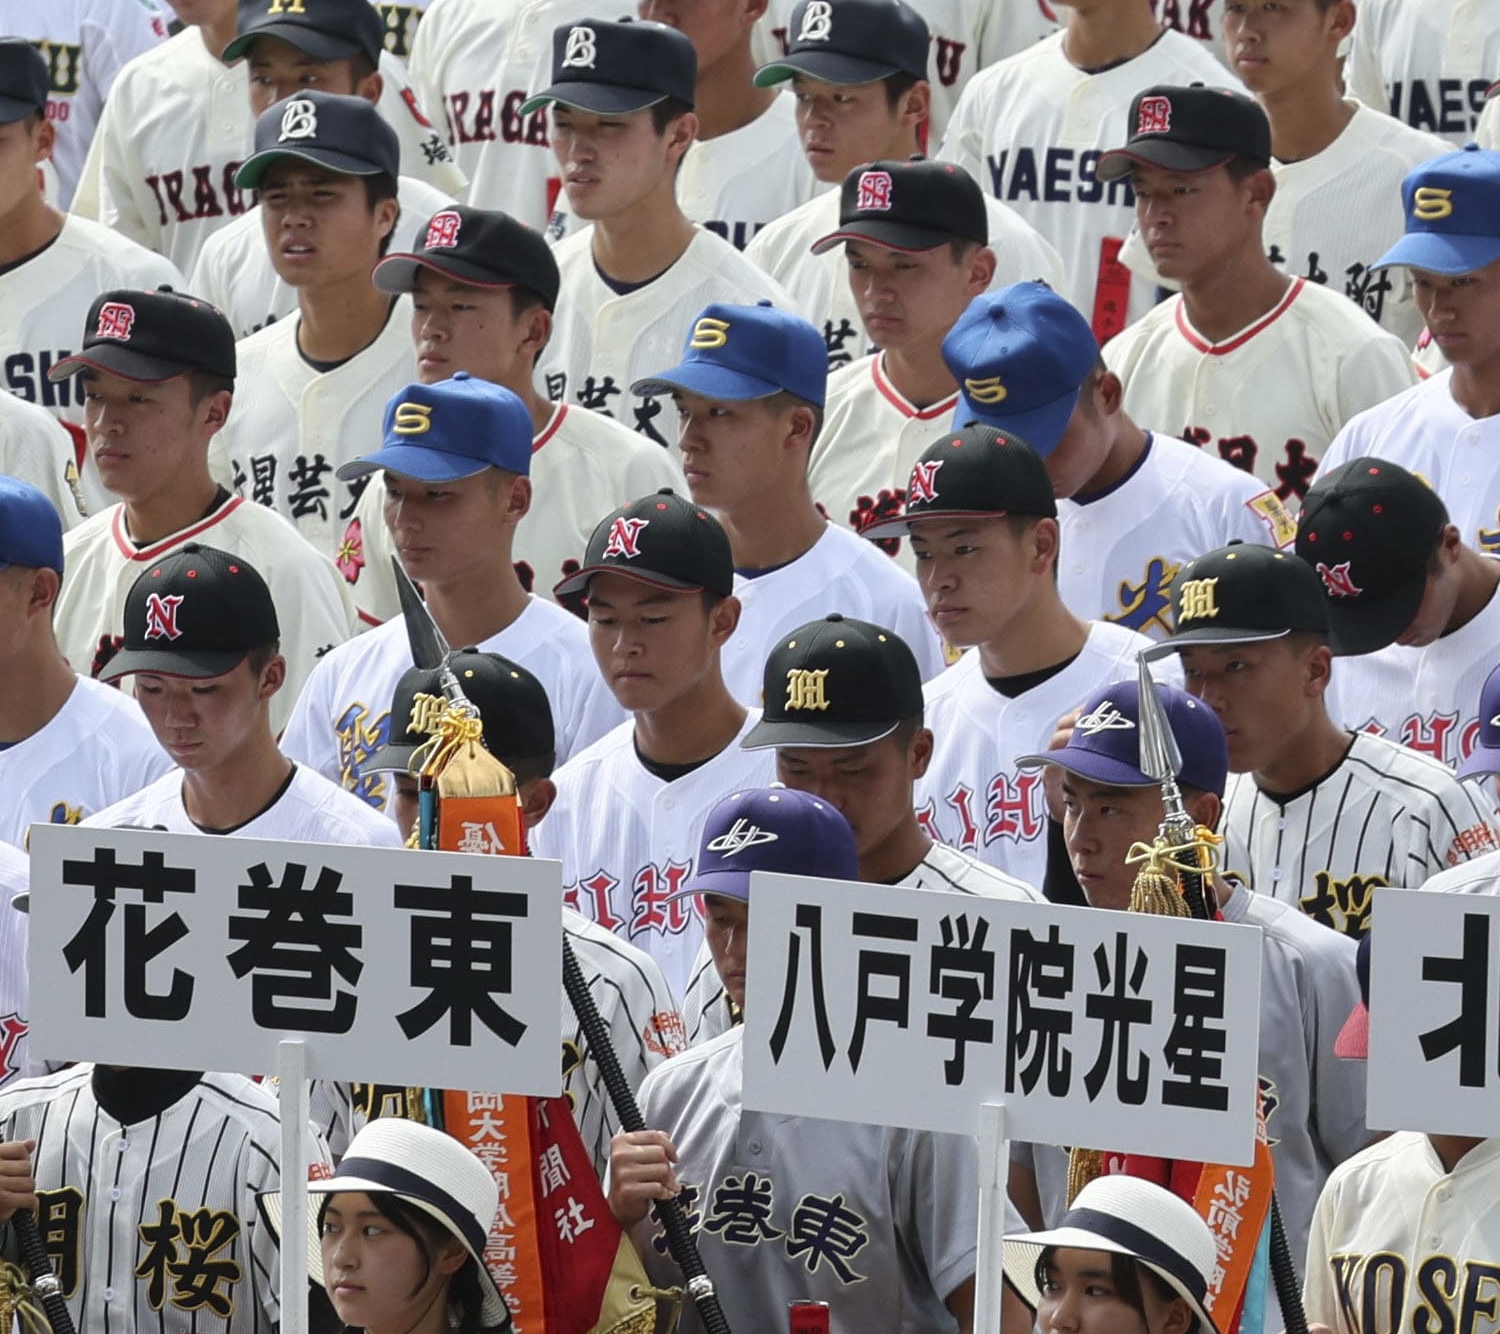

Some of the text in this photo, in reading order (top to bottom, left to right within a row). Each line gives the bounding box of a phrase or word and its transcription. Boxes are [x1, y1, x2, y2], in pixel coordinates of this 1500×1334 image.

[1412, 186, 1455, 220] S
[391, 402, 433, 435] S
[1173, 425, 1320, 506] 日大
[603, 516, 649, 560] N
[144, 593, 186, 641] N
[62, 848, 529, 1048] 花巻東
[768, 903, 1230, 1113] 八戸学院光星
